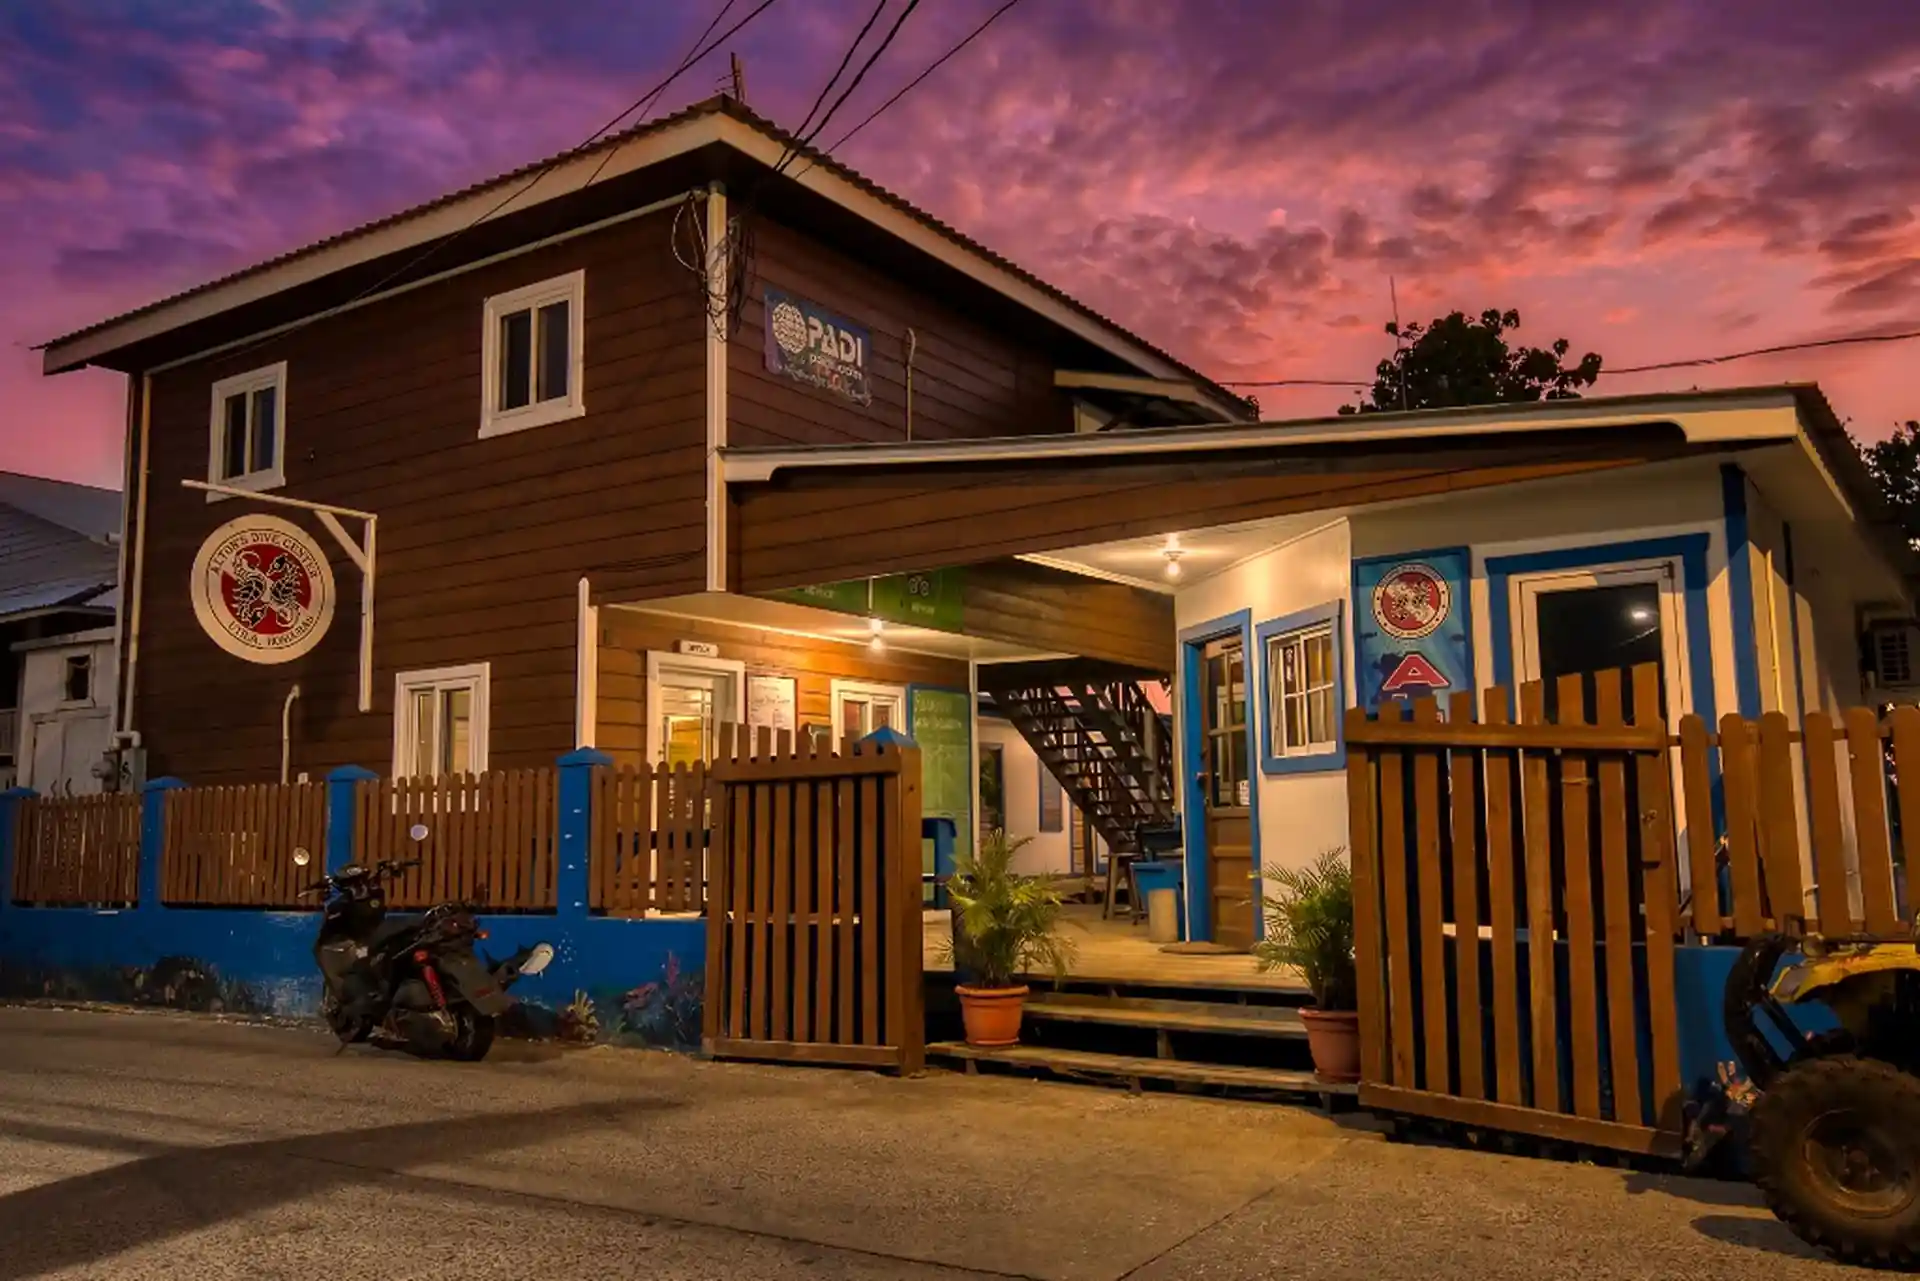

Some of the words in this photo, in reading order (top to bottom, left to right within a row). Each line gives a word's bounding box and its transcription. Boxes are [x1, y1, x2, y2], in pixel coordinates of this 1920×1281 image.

[807, 316, 863, 368] PADI
[251, 532, 281, 544] DIVE
[282, 539, 321, 578] CENTER
